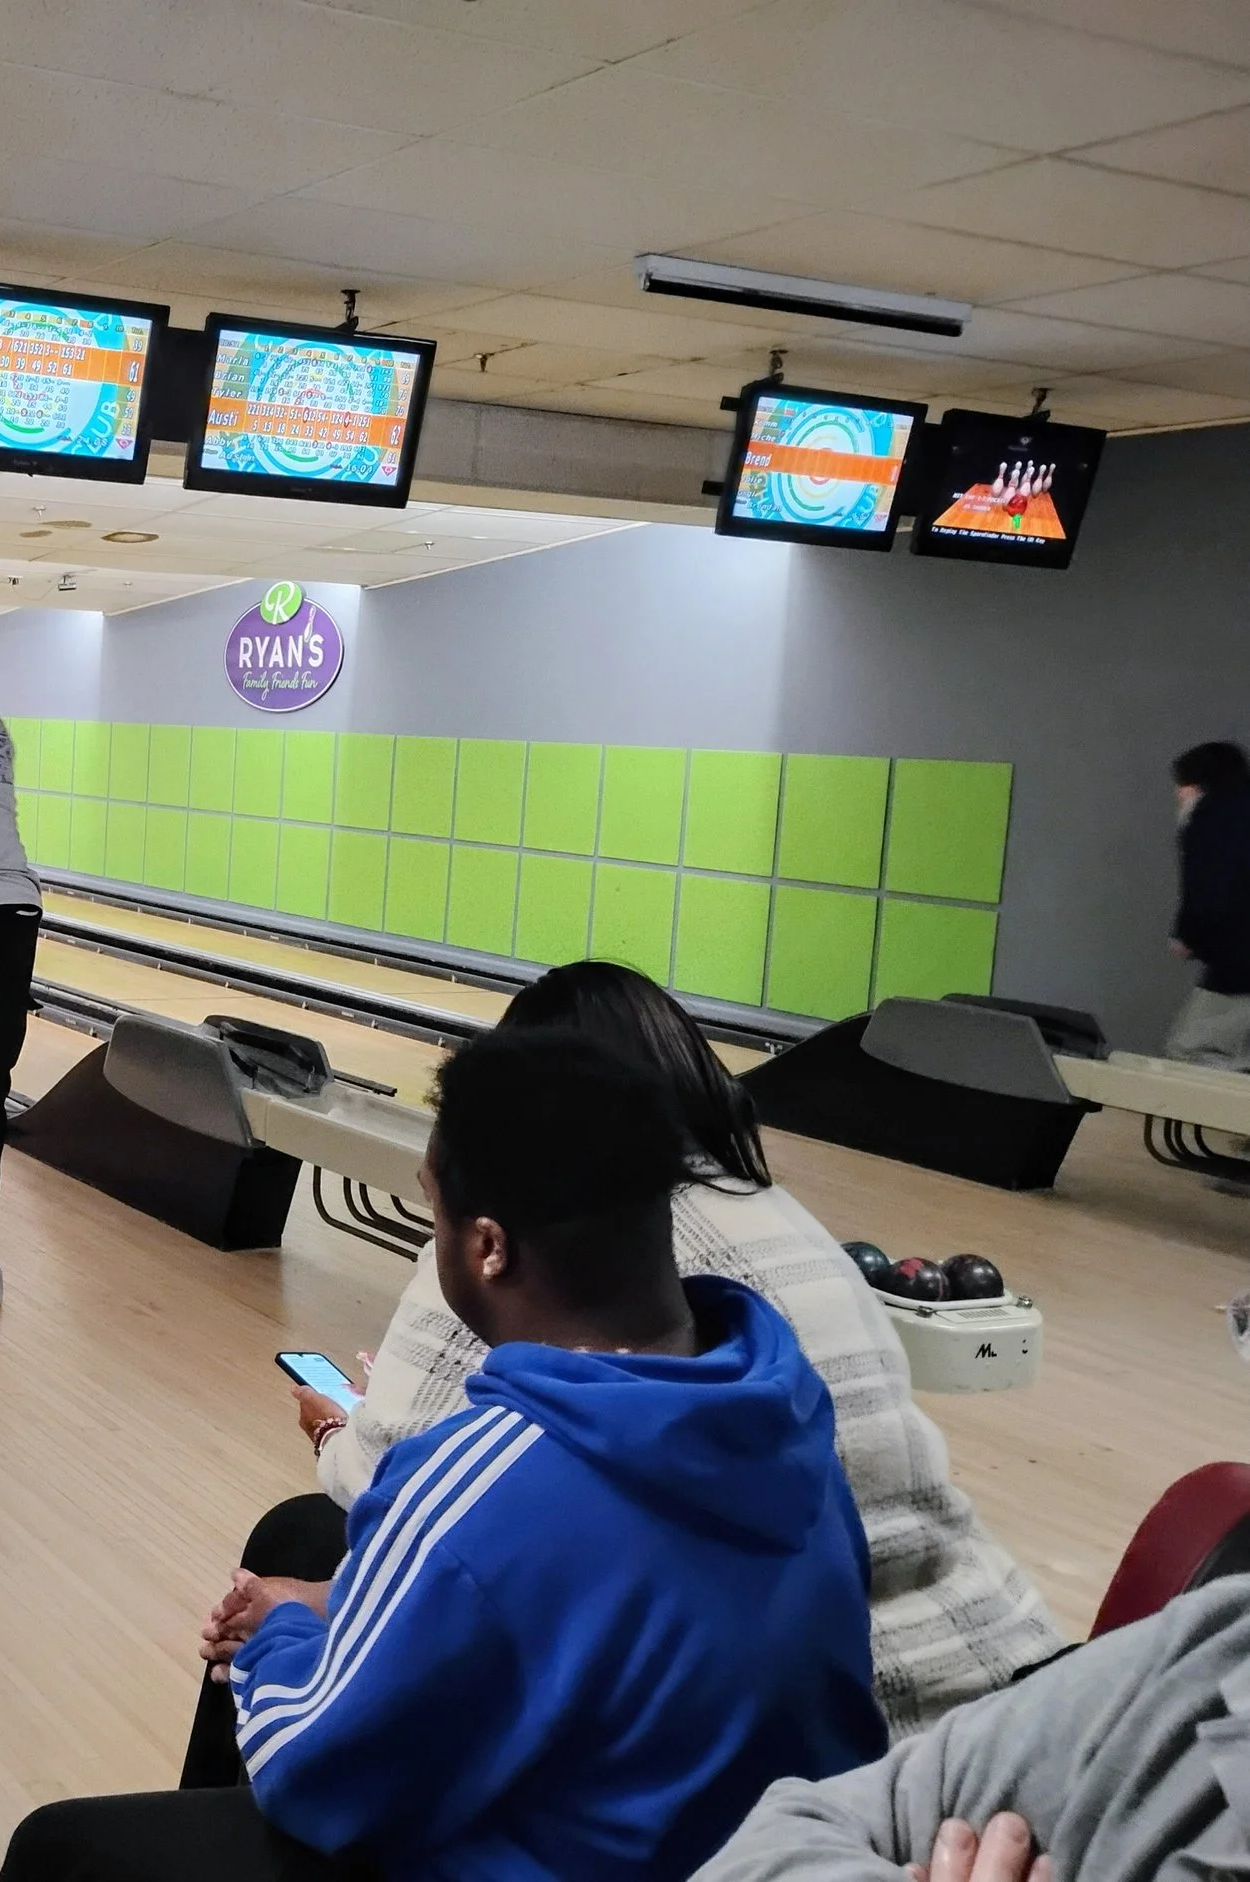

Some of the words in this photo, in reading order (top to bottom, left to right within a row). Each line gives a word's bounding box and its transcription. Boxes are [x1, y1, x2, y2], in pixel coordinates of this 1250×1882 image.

[13, 341, 27, 353] 621
[29, 343, 43, 355] 352
[60, 347, 74, 359] 153
[75, 349, 85, 360] 21
[133, 340, 142, 351] 39
[0, 355, 9, 367] 30
[15, 357, 25, 369] 39
[31, 359, 41, 371] 49
[46, 361, 57, 373] 52
[62, 363, 71, 375] 61
[216, 353, 249, 366] Maria
[128, 361, 139, 382] 61
[215, 371, 245, 382] Brian
[212, 387, 242, 399] Tyler
[247, 404, 260, 415] 221
[261, 405, 274, 417] 314
[330, 413, 343, 425] 124
[357, 416, 370, 428] 251
[208, 409, 239, 427] Austi
[389, 425, 401, 445] 62
[252, 420, 257, 430] 5
[290, 424, 299, 435] 24
[304, 426, 313, 437] 33
[318, 427, 327, 438] 42
[332, 429, 340, 439] 49
[345, 430, 354, 441] 54
[359, 432, 368, 442] 62
[205, 436, 231, 447] Abby
[745, 450, 771, 467] Brend
[264, 581, 295, 624] R
[238, 633, 325, 669] RYAN'S
[242, 670, 269, 701] Family
[271, 671, 299, 690] Friends
[300, 671, 319, 690] Fun
